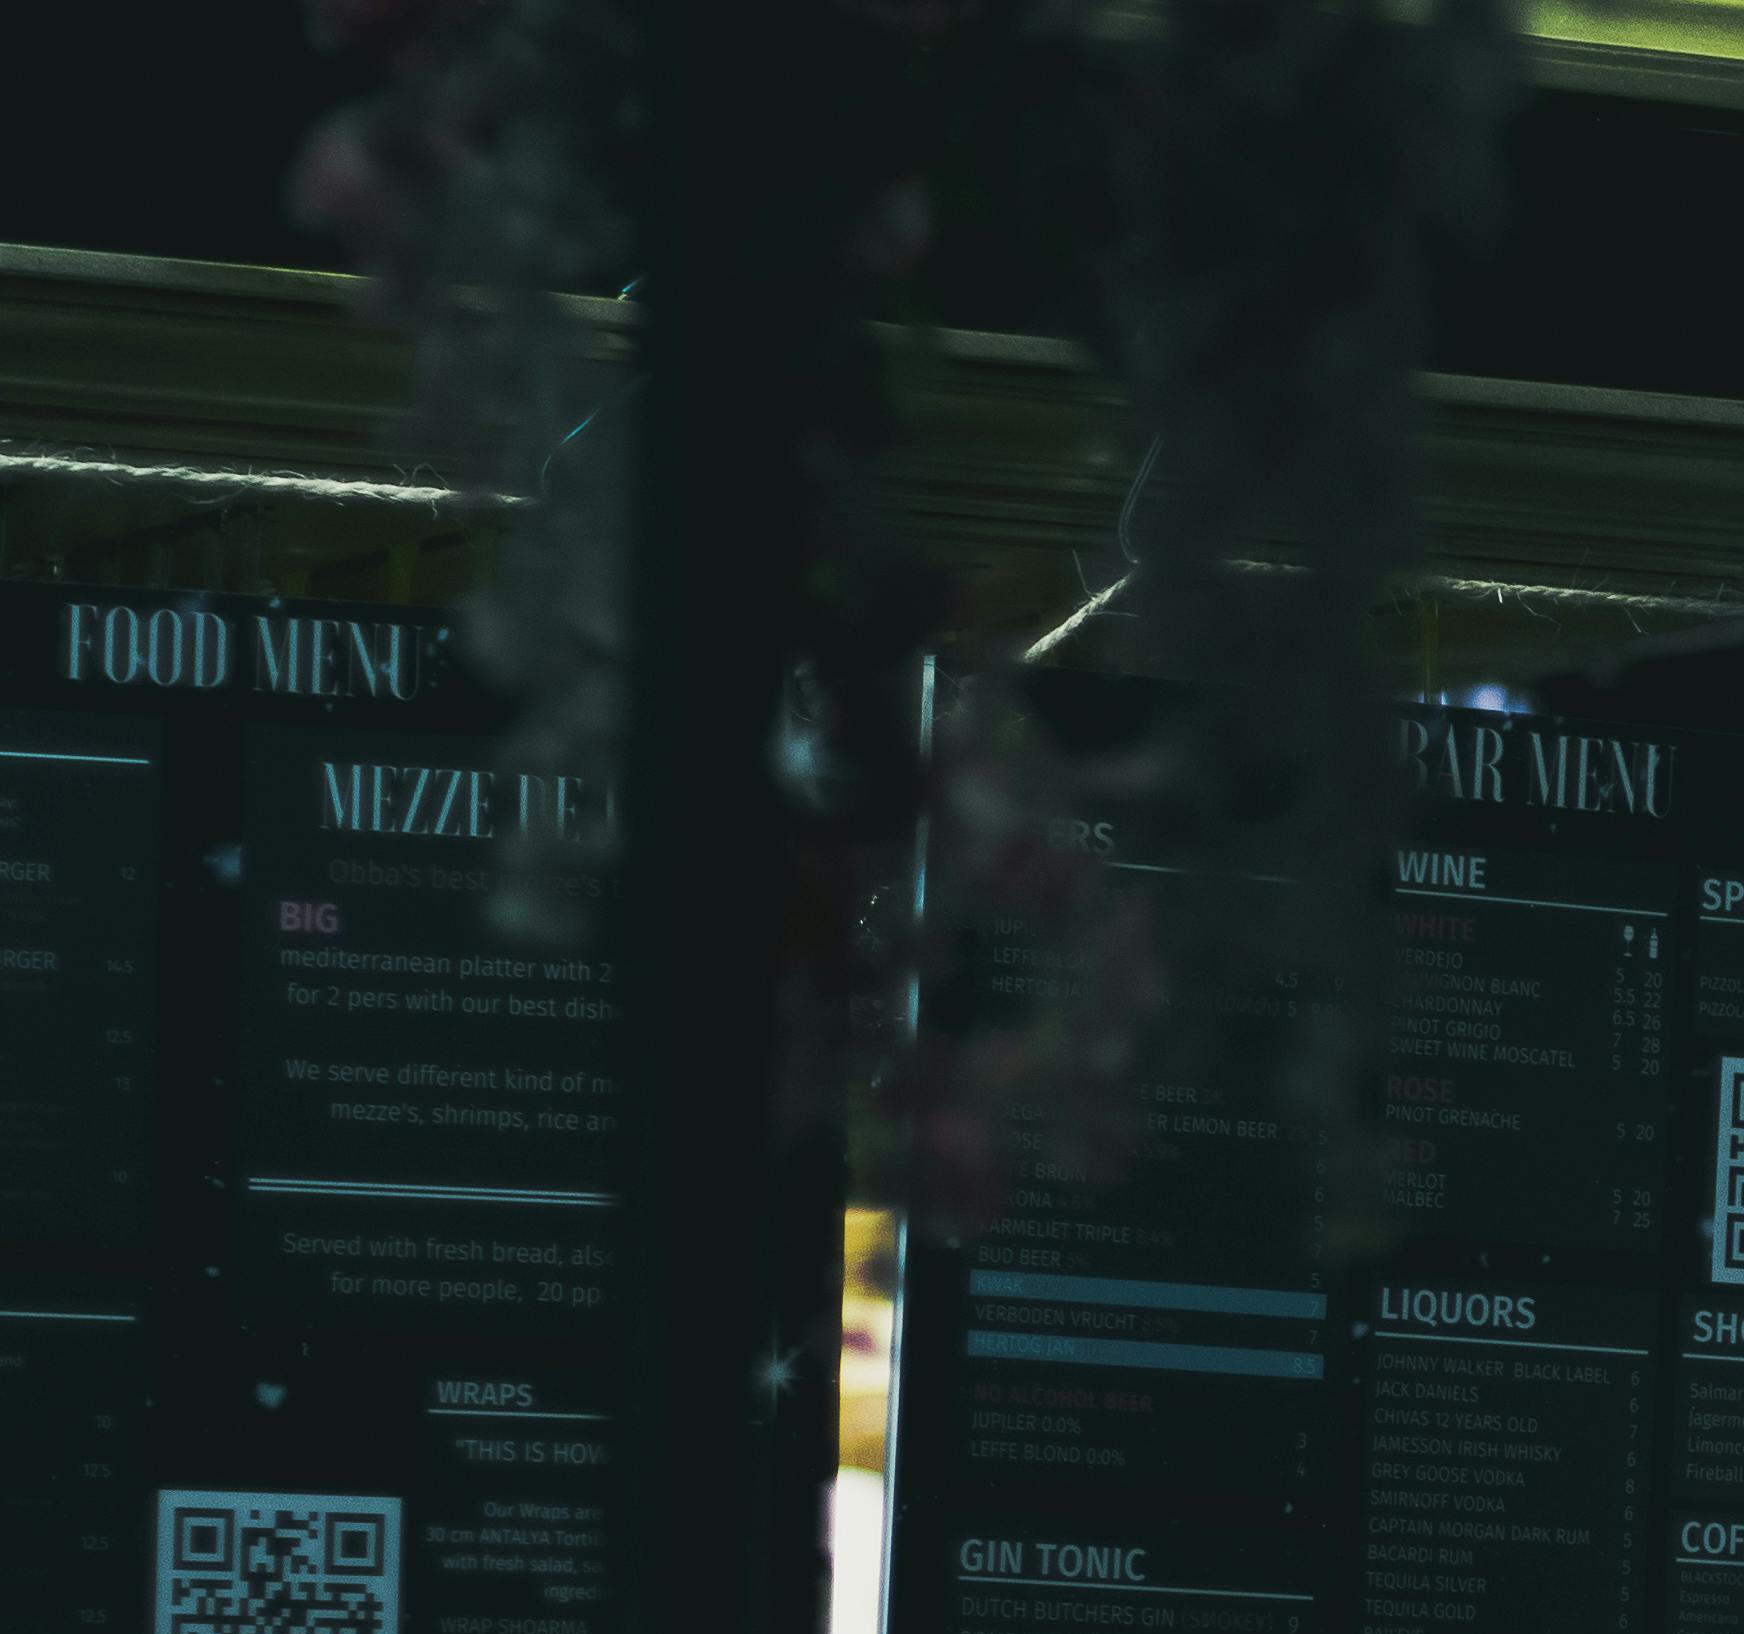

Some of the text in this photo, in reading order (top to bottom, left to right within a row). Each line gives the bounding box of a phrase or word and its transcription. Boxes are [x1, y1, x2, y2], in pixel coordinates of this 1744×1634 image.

[63, 602, 422, 701] FOOD MENU
[1398, 717, 1678, 818] BAR MENU
[321, 762, 496, 838] MEZZE
[1397, 850, 1487, 889] WINE
[279, 901, 340, 933] BIG
[281, 948, 450, 974] mediterranean
[460, 955, 536, 979] platter
[543, 959, 590, 981] with
[287, 983, 318, 1004] for
[327, 986, 340, 1006] 2
[348, 990, 397, 1012] pers
[405, 989, 453, 1013] with
[461, 995, 500, 1014] our
[509, 994, 558, 1018] best
[1447, 1042, 1488, 1062] WINE
[1493, 1047, 1576, 1069] MOSCATEL
[331, 1101, 578, 1131] mezze's, shrimps, rice
[1385, 1104, 1521, 1131] PINOT GRENACHE
[283, 1232, 361, 1257] Served
[370, 1235, 417, 1259] with
[426, 1237, 484, 1261] fresh
[492, 1242, 564, 1268] bread,
[977, 1246, 1062, 1268] BUD BEER
[330, 1271, 365, 1295] for
[372, 1278, 431, 1298] more
[439, 1279, 524, 1304] people,
[536, 1282, 564, 1303] 20
[1380, 1287, 1537, 1330] LIQUORS
[1376, 1353, 1611, 1386] JOHNNY WALKER BLACK LABEL
[437, 1380, 533, 1408] WRAPS
[1375, 1380, 1480, 1403] JACK DANIELS
[524, 1441, 545, 1463] IS
[1368, 1516, 1591, 1546] CAPTAIN MORGAN DARK RUM
[959, 1538, 1147, 1581] GIN TONIC
[961, 1596, 1026, 1618] DUTCH
[1034, 1601, 1135, 1626] BUTCHERS
[1141, 1607, 1175, 1628] GIN
